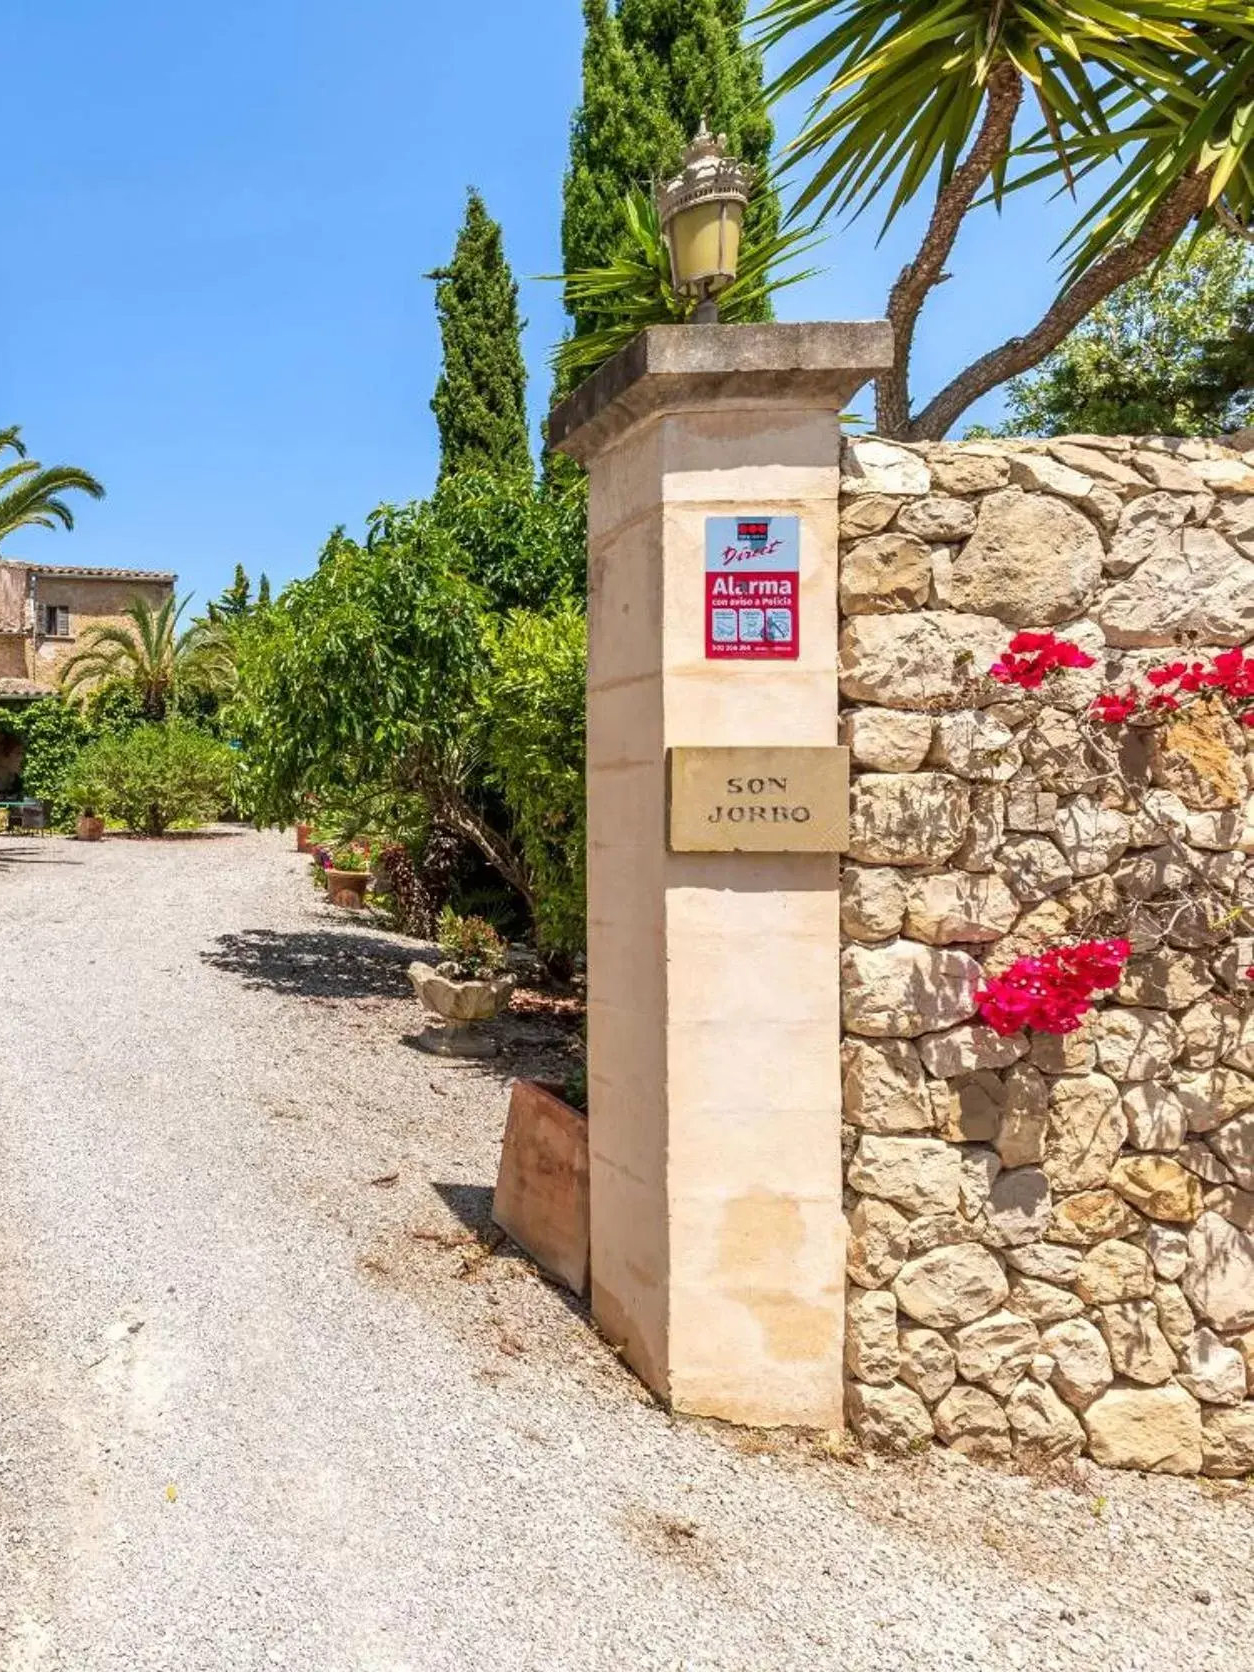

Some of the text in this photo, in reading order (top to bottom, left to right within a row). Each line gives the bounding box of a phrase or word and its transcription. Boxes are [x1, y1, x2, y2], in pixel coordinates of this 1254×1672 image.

[722, 539, 783, 566] Direct
[713, 576, 792, 595] Alarma
[729, 597, 753, 606] aviso
[726, 777, 788, 794] SON
[708, 806, 810, 823] JORBO
